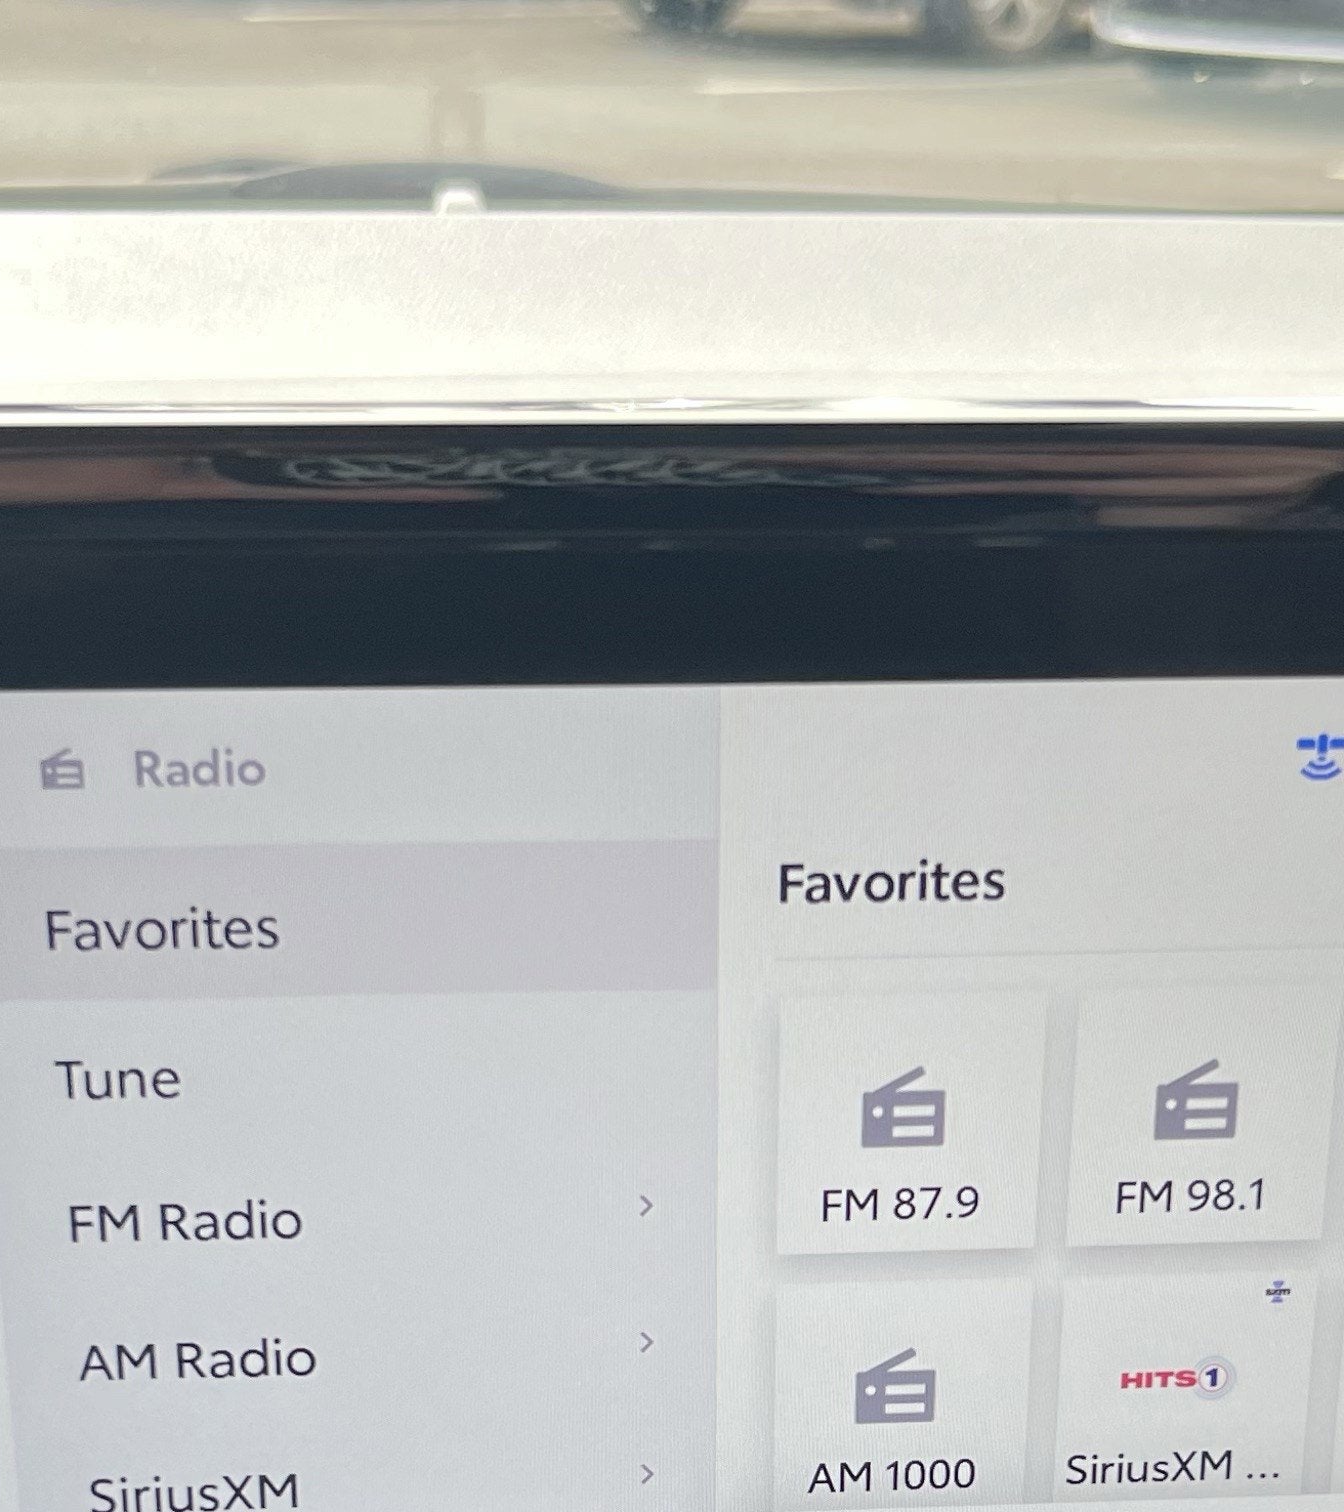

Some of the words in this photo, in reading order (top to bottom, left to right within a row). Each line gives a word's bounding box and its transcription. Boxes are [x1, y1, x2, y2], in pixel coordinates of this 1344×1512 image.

[133, 747, 267, 788] Radio
[778, 858, 1006, 905] Favorites
[45, 905, 281, 952] Favorites
[54, 1060, 182, 1101] Tune
[821, 1188, 879, 1223] FM
[893, 1185, 981, 1221] 87.9
[1115, 1180, 1173, 1215] FM
[1187, 1177, 1265, 1213] 98.1
[69, 1204, 140, 1244] FM
[159, 1198, 303, 1242] Radio
[79, 1343, 158, 1382] AM
[175, 1337, 318, 1380] Radio
[807, 1461, 873, 1494] AM
[886, 1458, 977, 1491] 1000
[1065, 1449, 1233, 1486] SiriusXM
